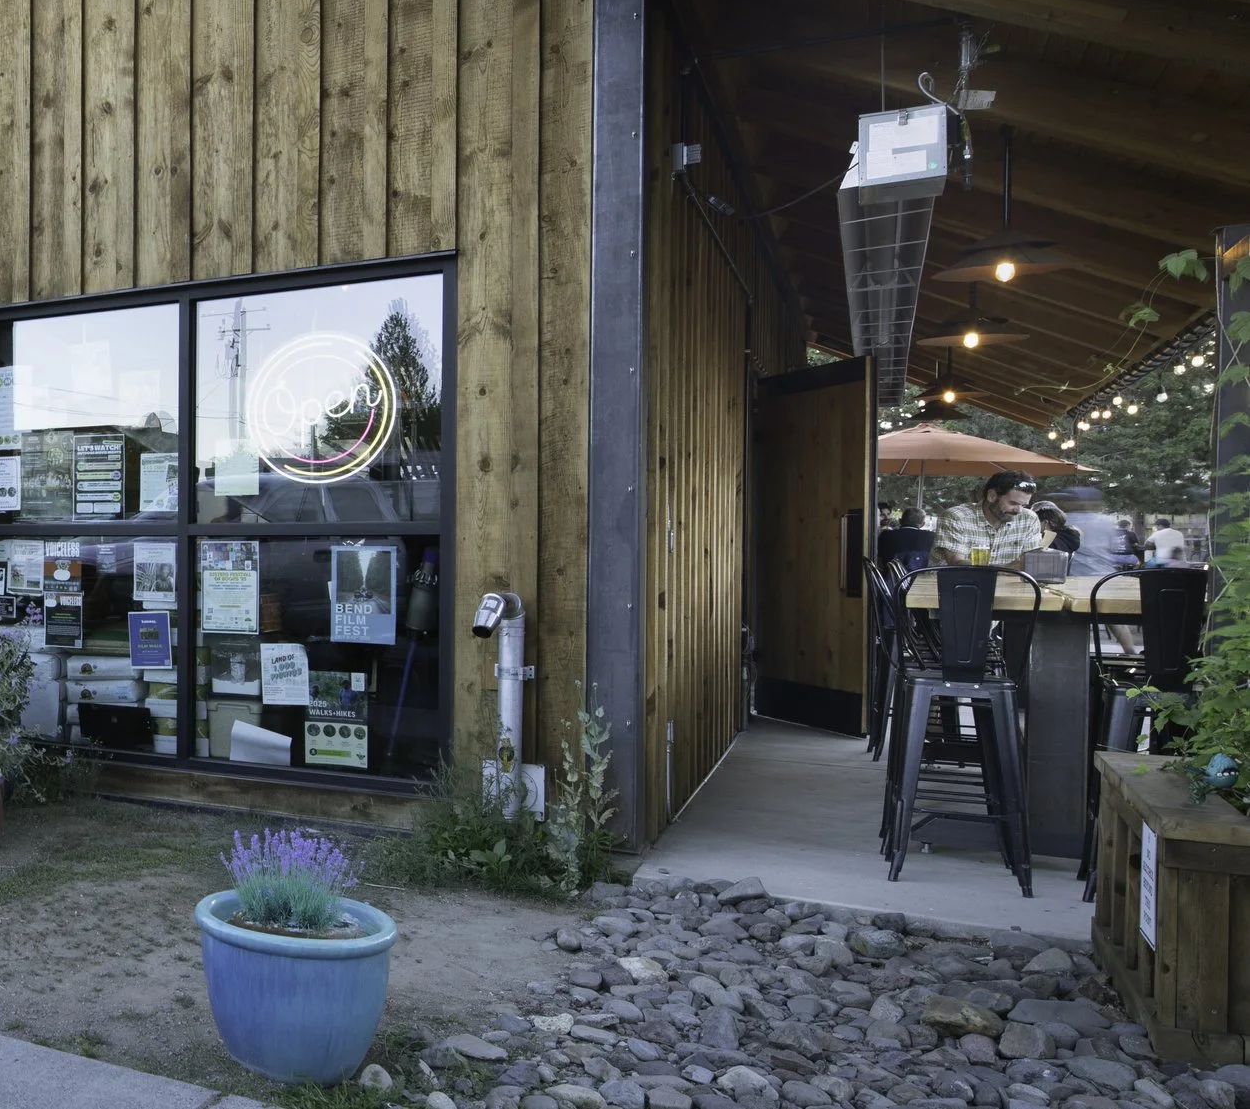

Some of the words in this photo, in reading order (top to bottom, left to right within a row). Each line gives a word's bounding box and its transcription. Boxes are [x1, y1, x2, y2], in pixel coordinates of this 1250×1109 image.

[263, 381, 383, 449] Open
[45, 541, 80, 557] VOICELESS
[335, 603, 373, 614] BEND
[335, 614, 366, 625] FILM
[335, 625, 369, 636] FEST
[271, 655, 287, 664] LAND
[309, 700, 327, 708] 2025
